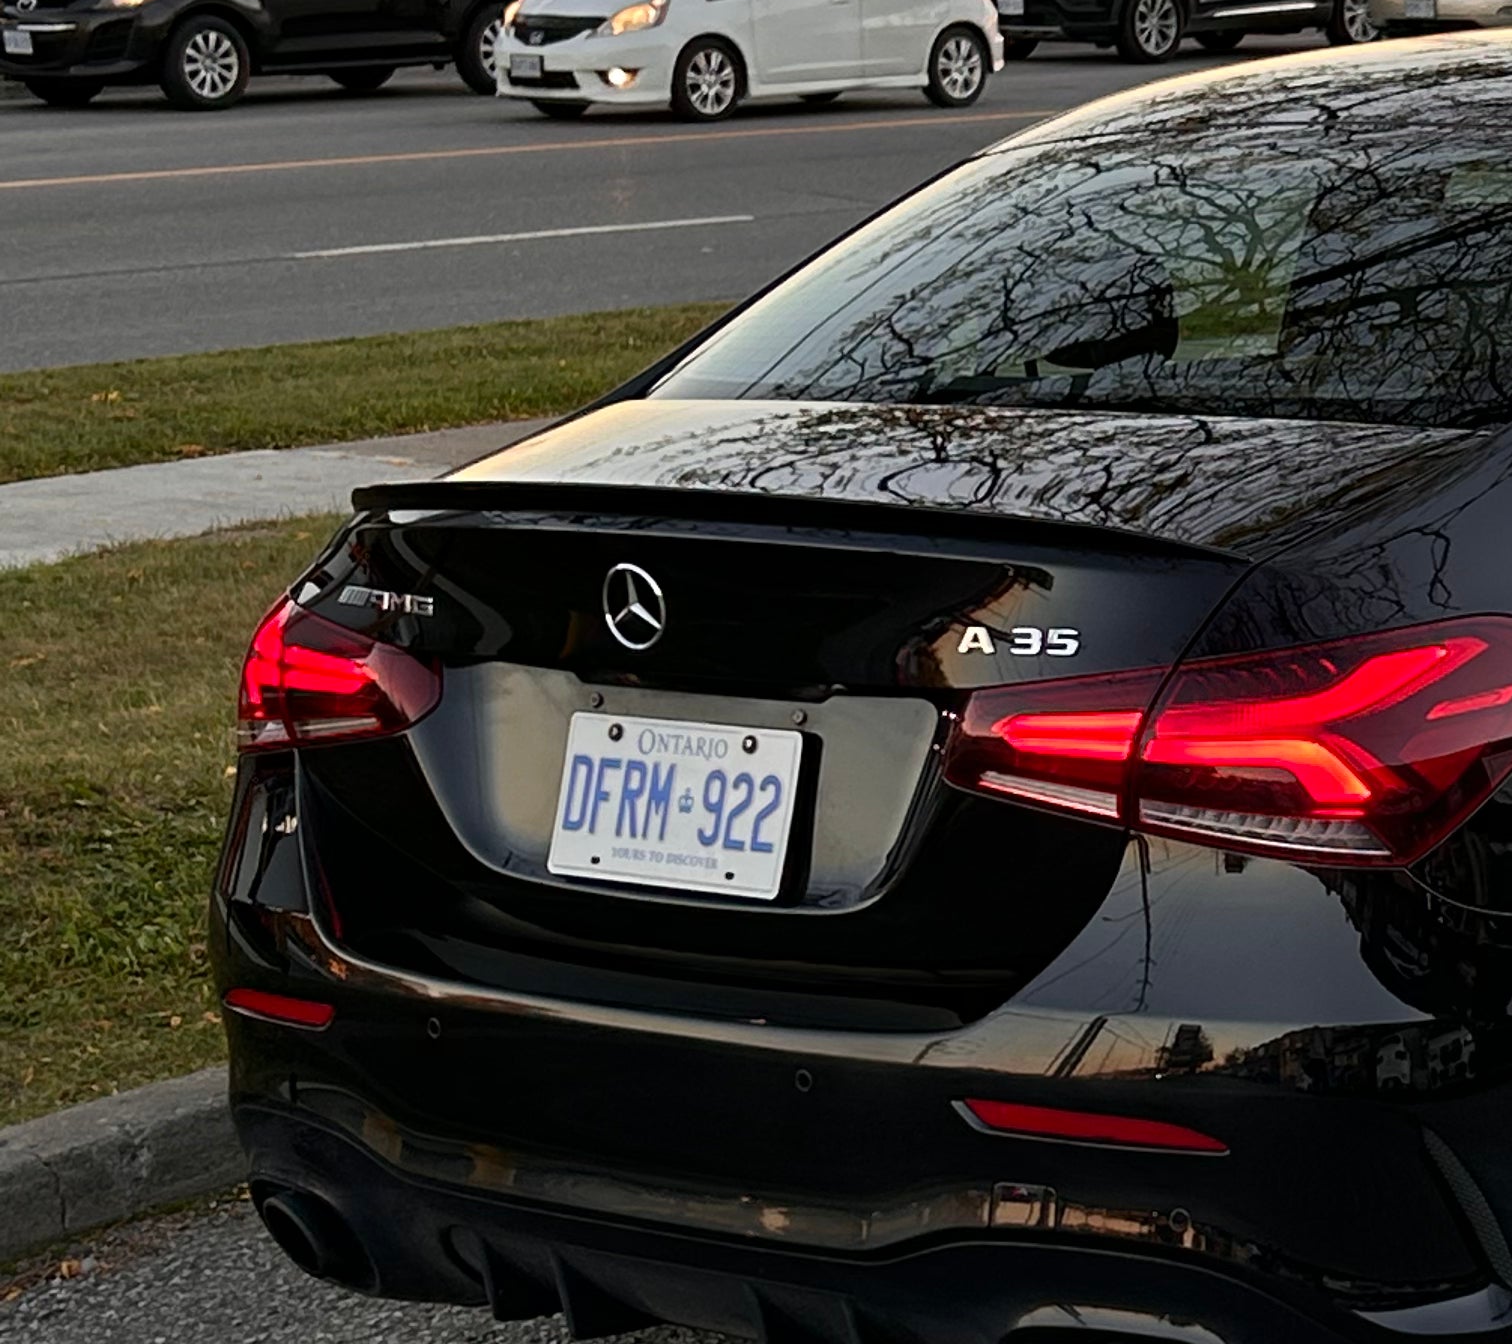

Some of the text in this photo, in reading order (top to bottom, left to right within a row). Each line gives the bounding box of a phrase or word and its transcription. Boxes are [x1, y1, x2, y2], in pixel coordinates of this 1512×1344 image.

[957, 626, 1079, 656] A 35
[637, 728, 729, 761] ONTARIO
[561, 753, 783, 854] DFRM 922
[611, 847, 719, 870] YOURS TO DISCOVER
